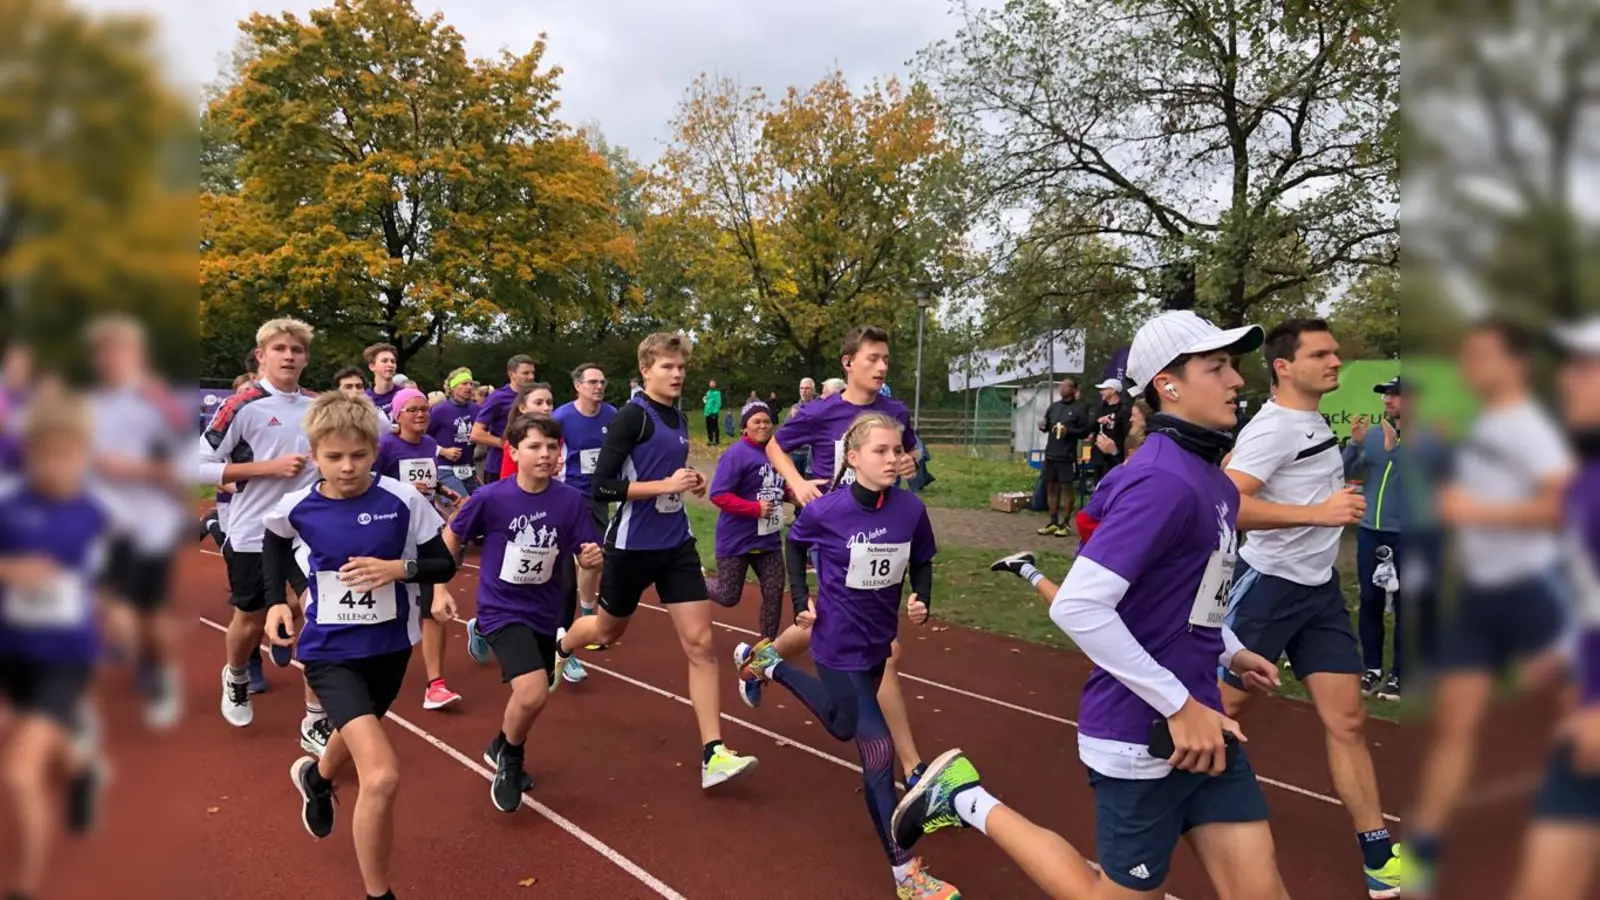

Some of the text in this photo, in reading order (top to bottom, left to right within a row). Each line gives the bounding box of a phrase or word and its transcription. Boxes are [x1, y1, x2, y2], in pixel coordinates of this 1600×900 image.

[409, 469, 432, 481] 594
[373, 512, 398, 521] Sempt
[508, 511, 547, 532] 40 Jahre
[868, 526, 887, 540] Jahre
[518, 559, 543, 574] 34
[870, 558, 890, 577] 18
[862, 579, 891, 587] SILENCA
[339, 590, 376, 609] 44
[1214, 579, 1230, 607] 48
[337, 613, 378, 621] SILENCA
